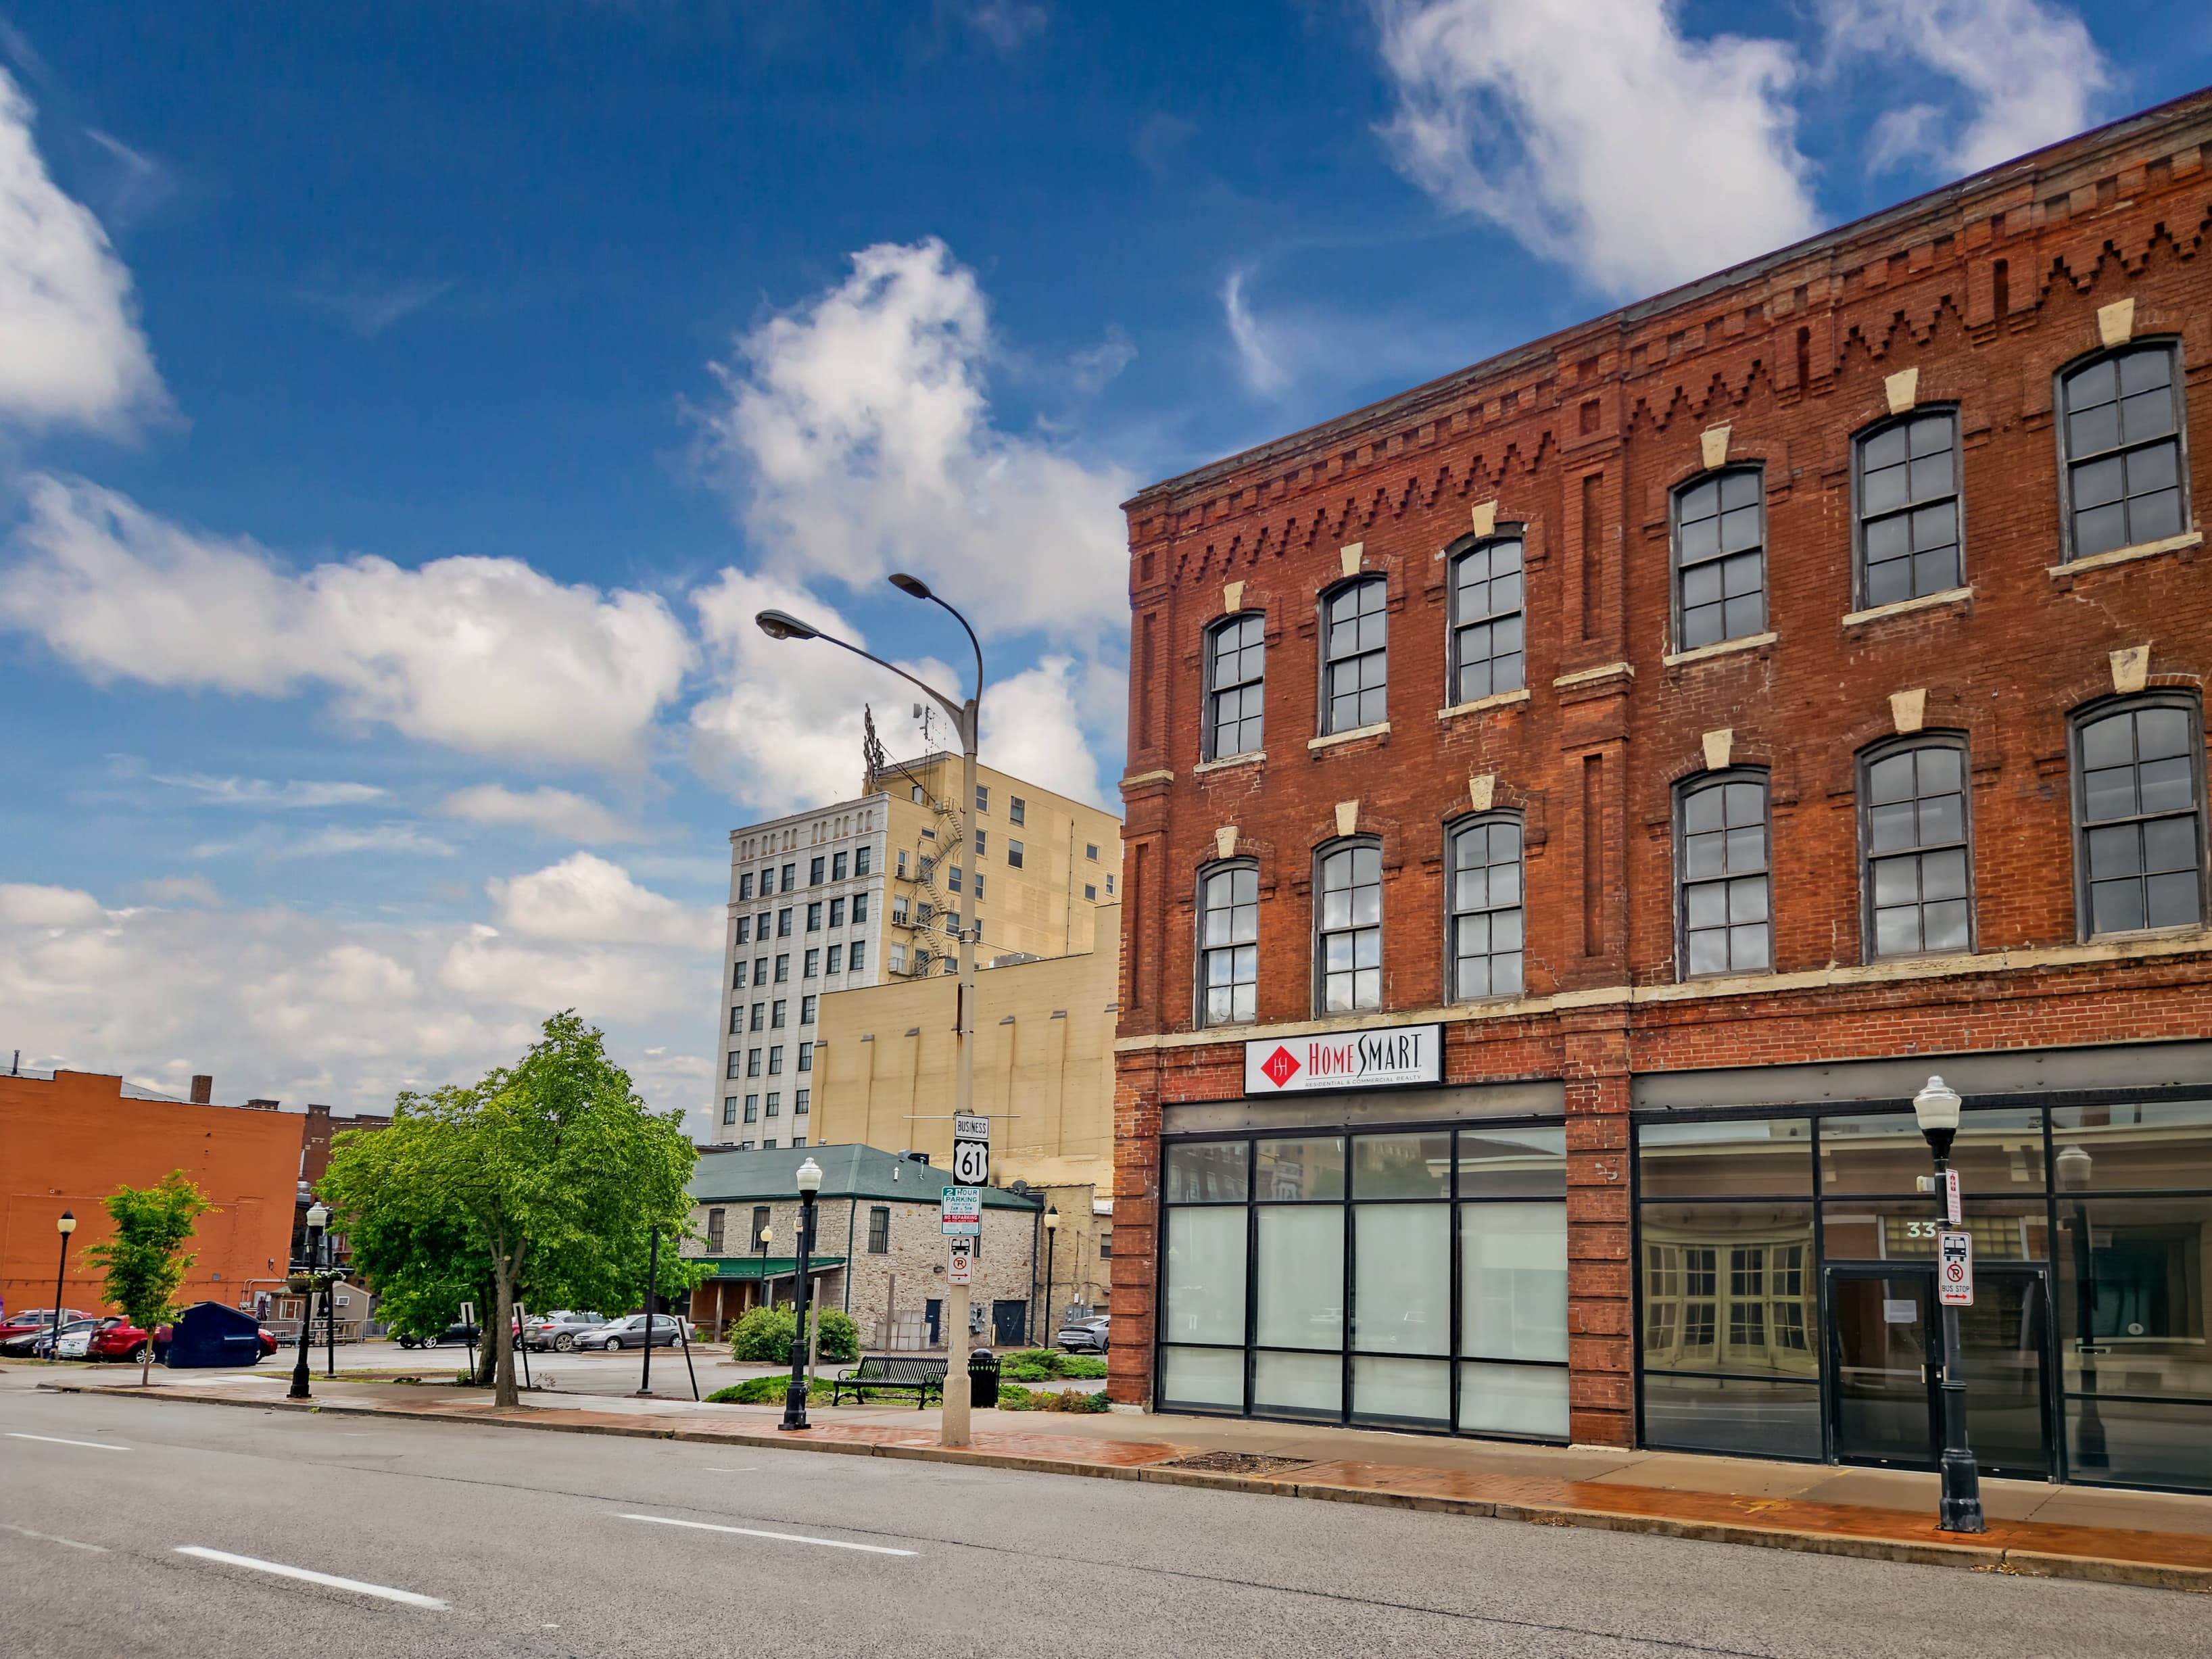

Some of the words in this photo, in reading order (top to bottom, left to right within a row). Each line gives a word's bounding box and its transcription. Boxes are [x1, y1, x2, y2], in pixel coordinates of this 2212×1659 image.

[958, 1121, 986, 1134] BUSINESS
[962, 1151, 980, 1176] 61
[1906, 1222, 1936, 1238] 33
